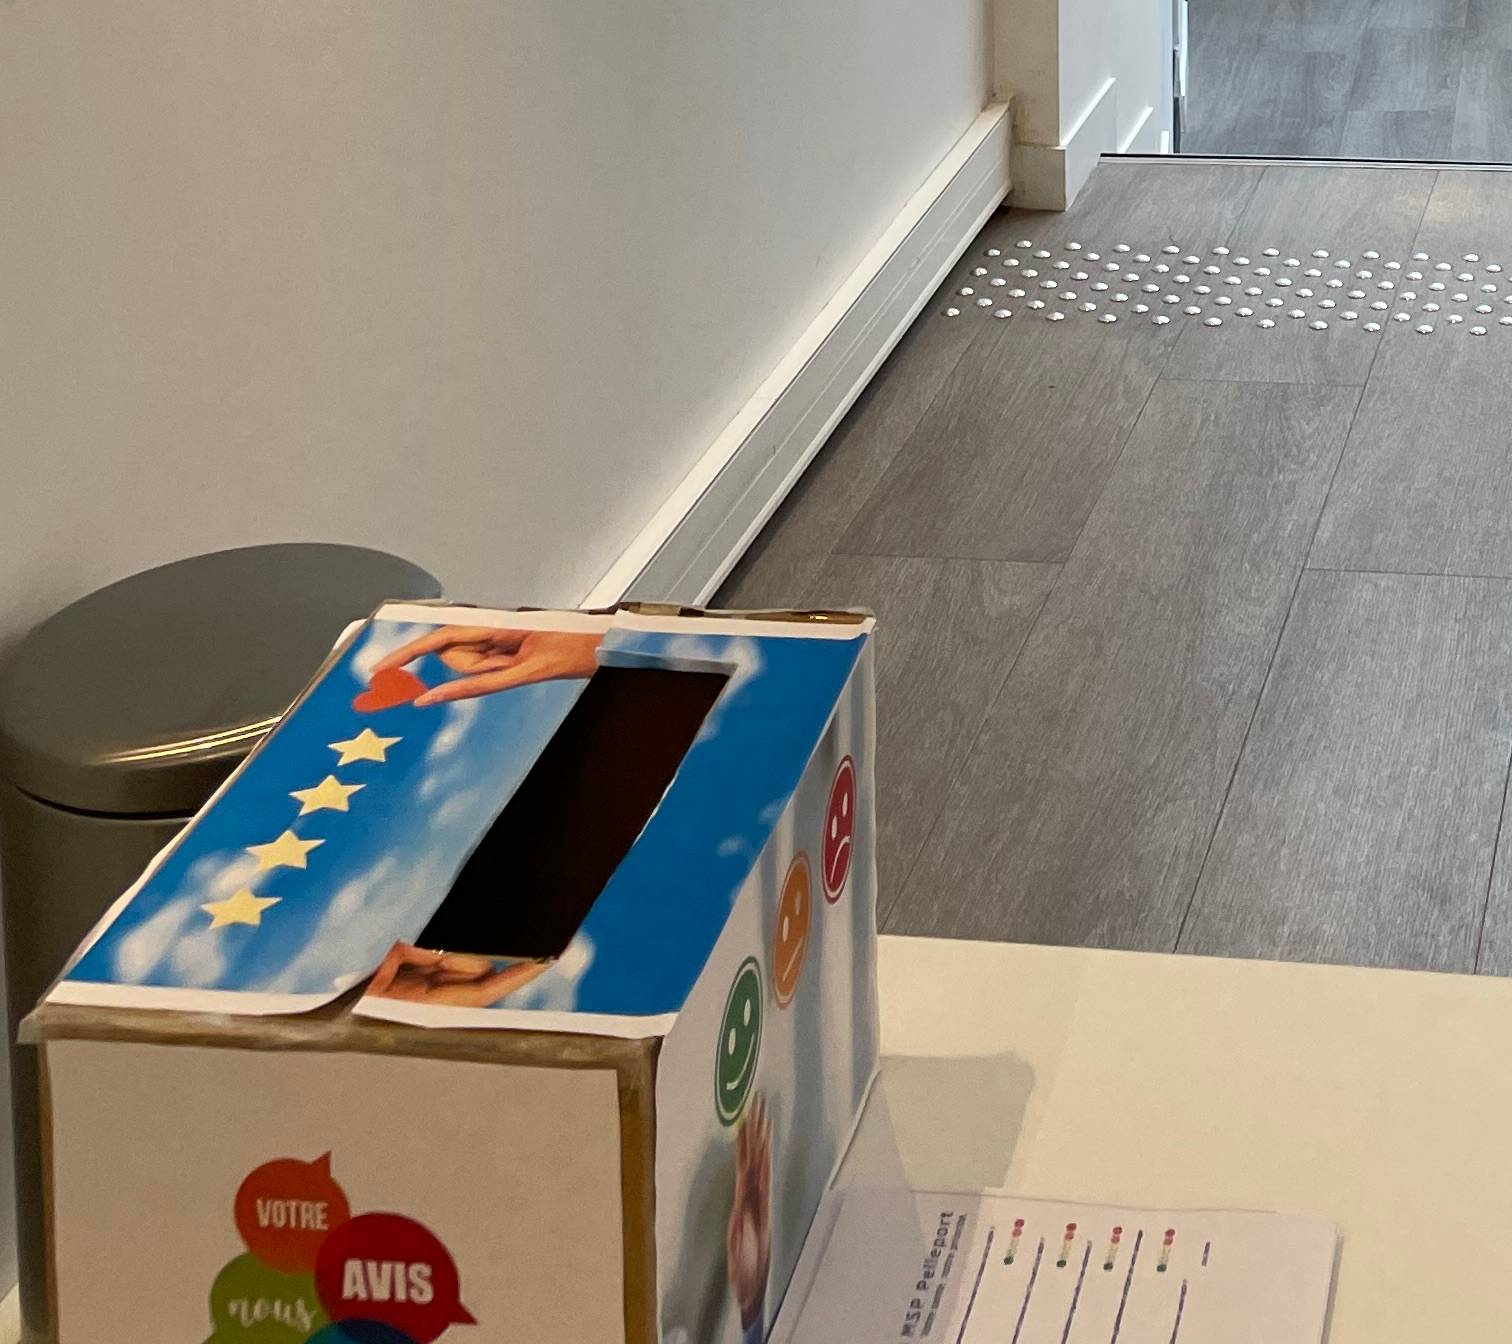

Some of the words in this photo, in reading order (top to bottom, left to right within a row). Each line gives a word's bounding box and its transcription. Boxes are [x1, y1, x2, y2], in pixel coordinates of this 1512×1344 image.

[256, 1198, 329, 1230] VOTRE
[916, 1211, 954, 1291] Pelleport
[342, 1258, 435, 1305] AVIS
[228, 1297, 316, 1333] nous
